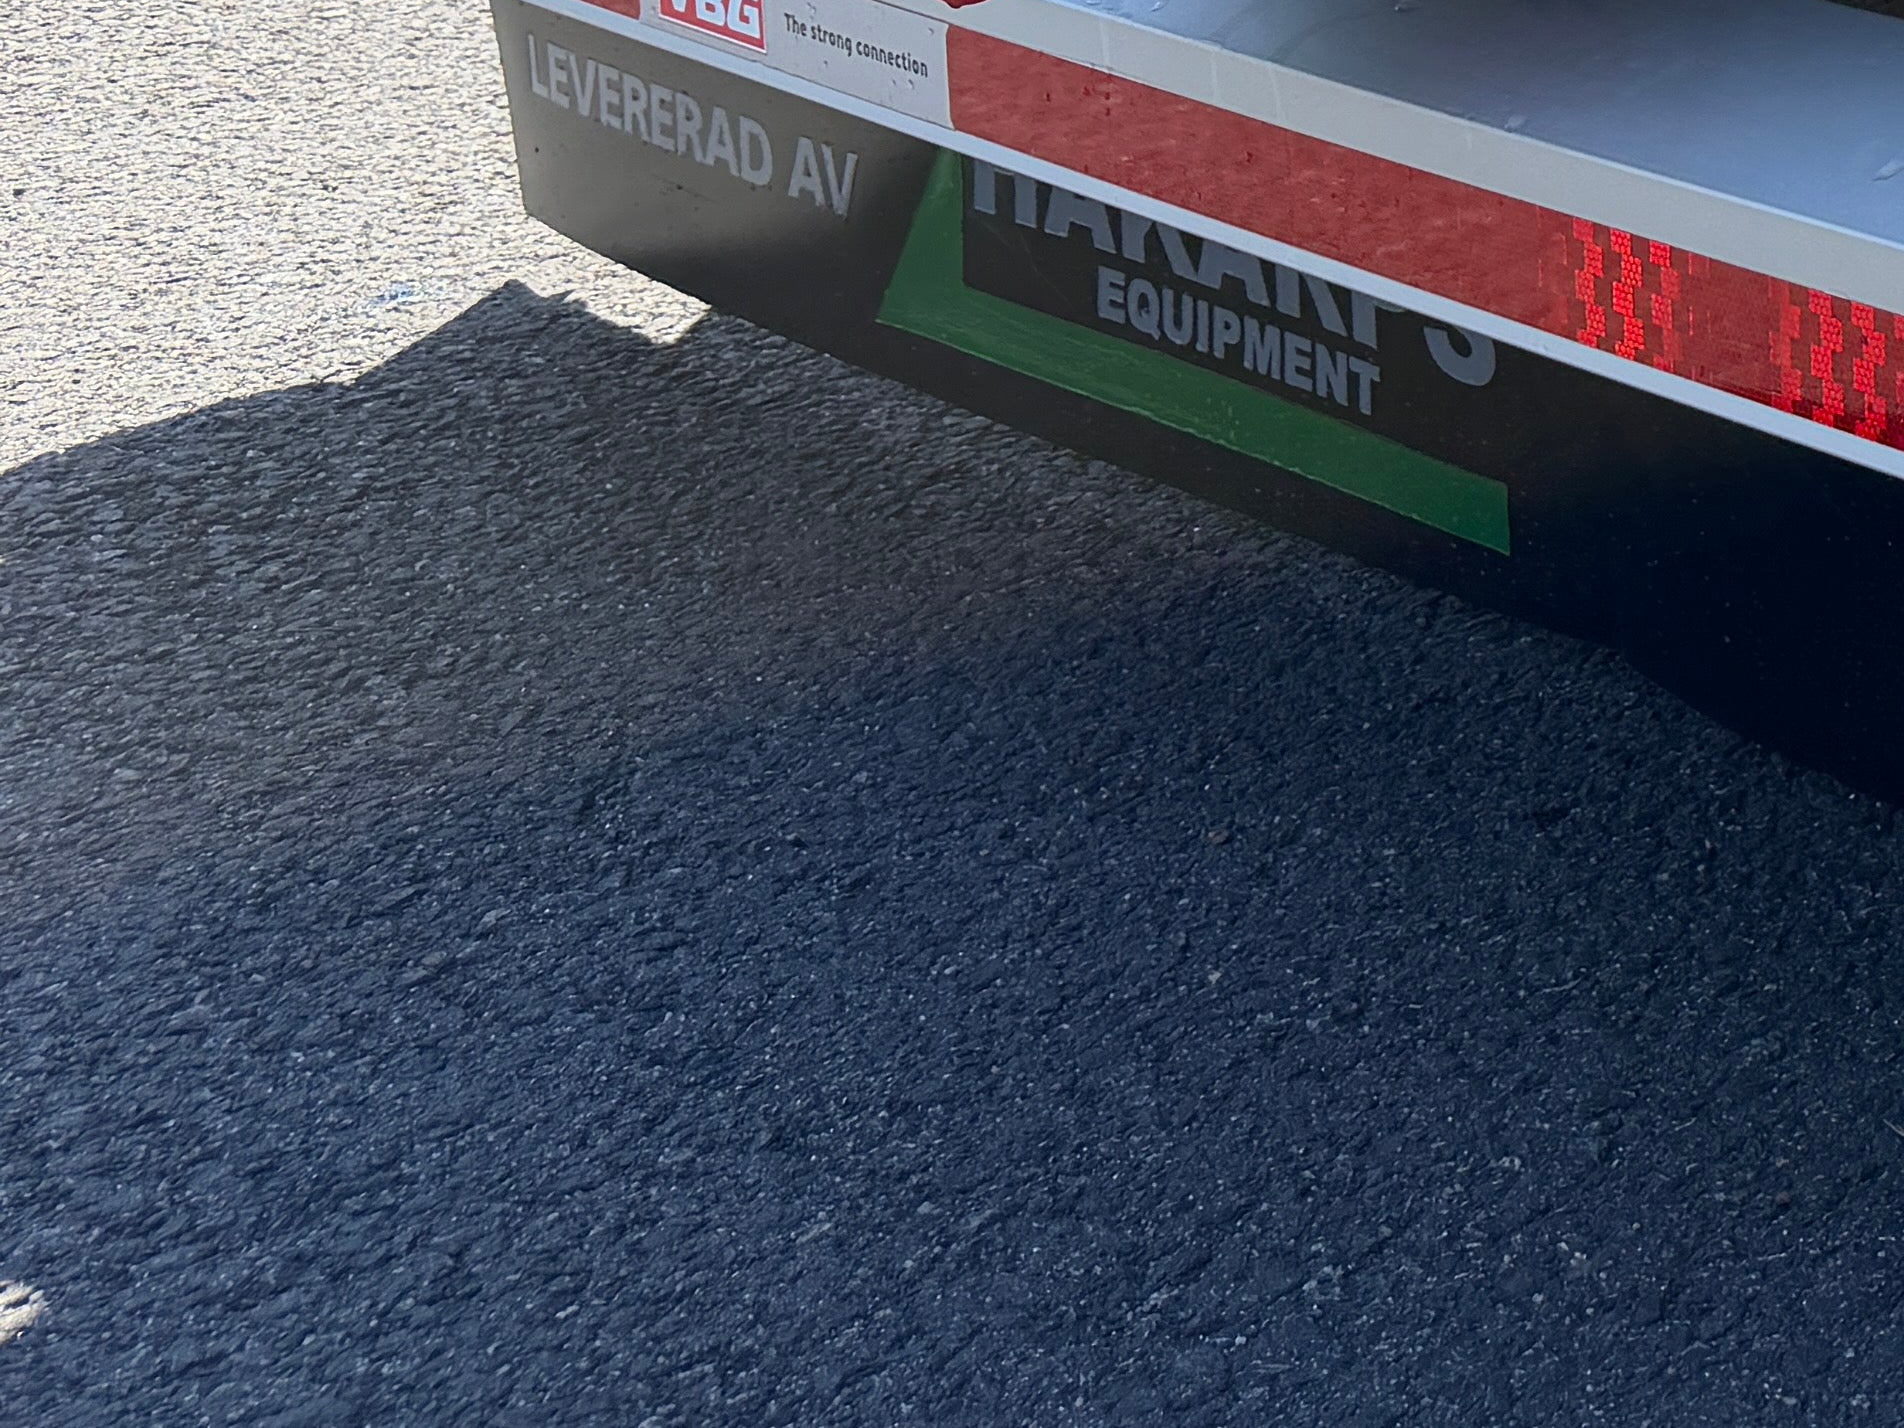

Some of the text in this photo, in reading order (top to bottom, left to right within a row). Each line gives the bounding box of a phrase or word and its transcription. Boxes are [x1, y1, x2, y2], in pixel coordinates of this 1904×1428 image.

[784, 12, 930, 79] The strong connection
[528, 33, 859, 220] LEVERERAD AV
[1097, 265, 1382, 417] EQUIPMENT
